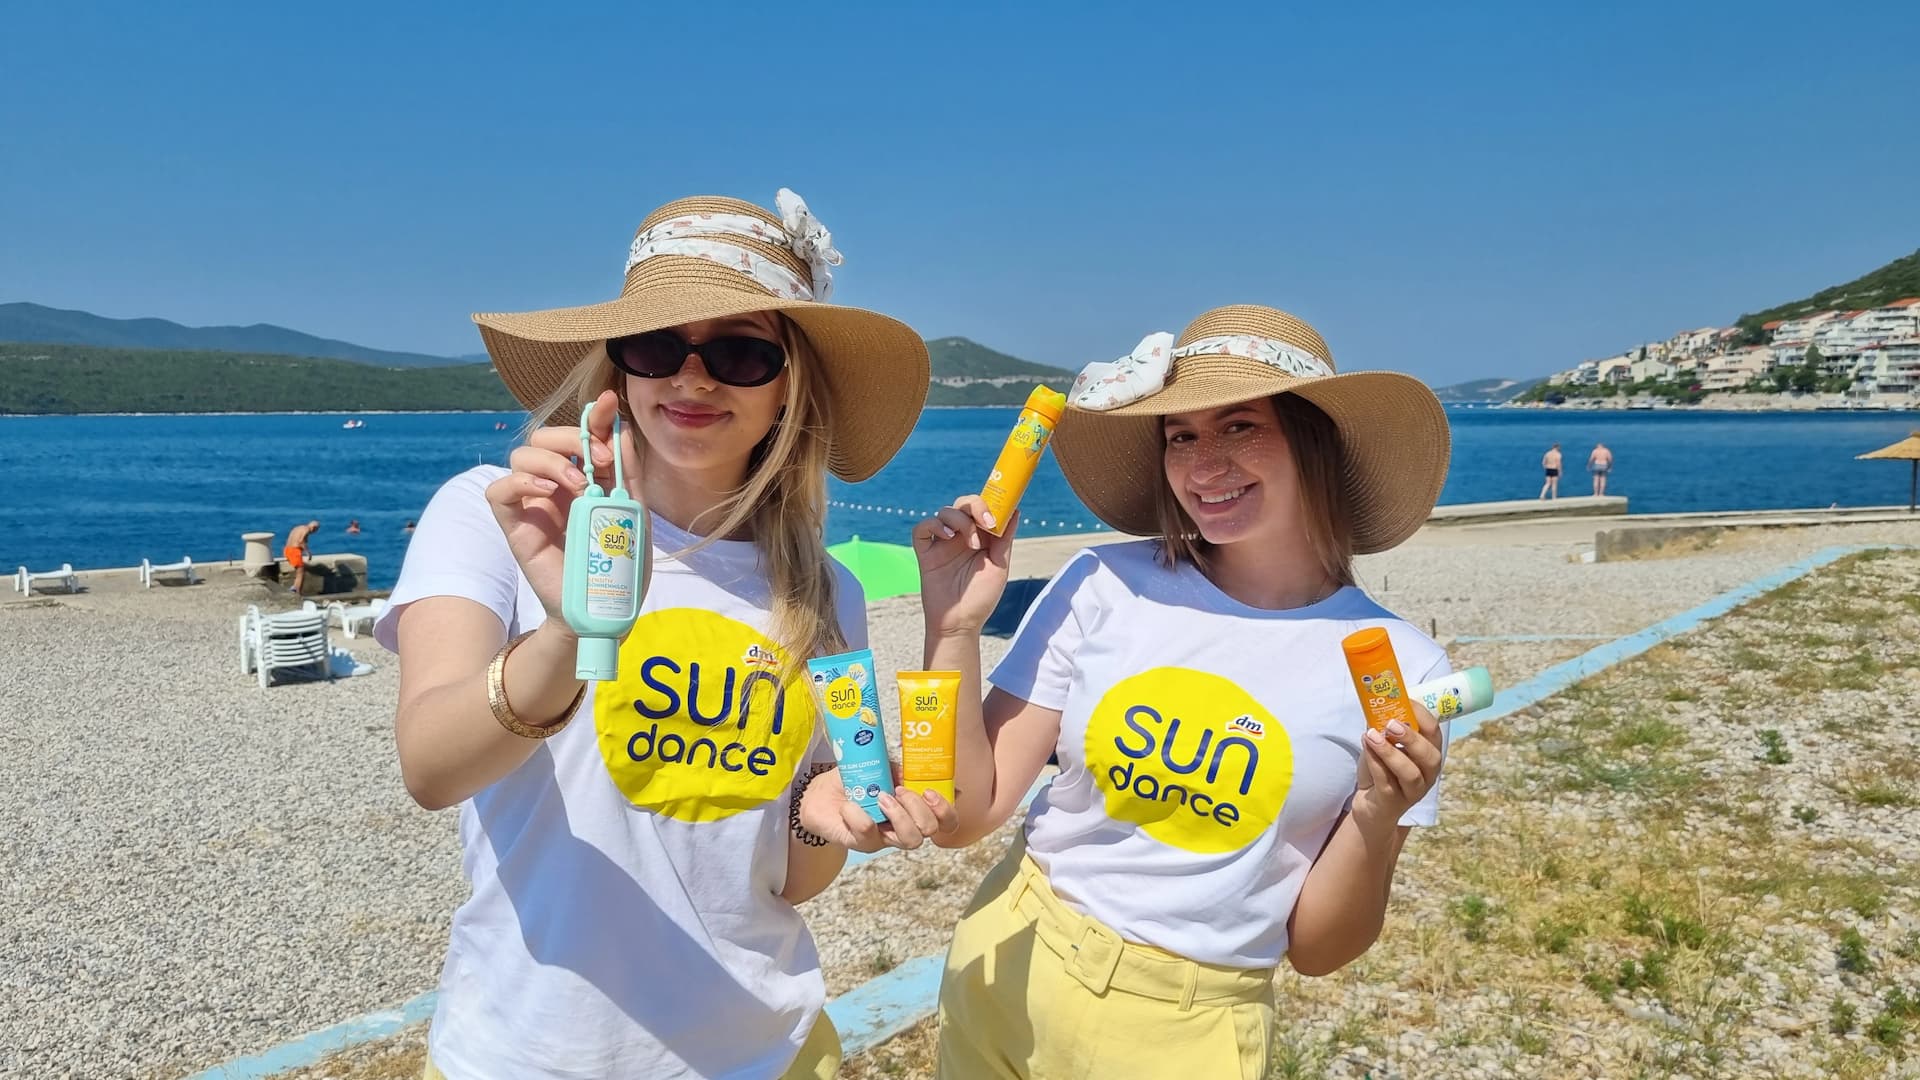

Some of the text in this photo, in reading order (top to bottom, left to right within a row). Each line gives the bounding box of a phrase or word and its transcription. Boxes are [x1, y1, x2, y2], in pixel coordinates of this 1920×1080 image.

[588, 559, 612, 574] 50
[832, 701, 856, 710] dance
[1369, 696, 1386, 707] 50
[905, 721, 932, 739] 30
[1235, 716, 1262, 731] dm
[627, 723, 777, 776] dance
[1108, 762, 1240, 828] dance
